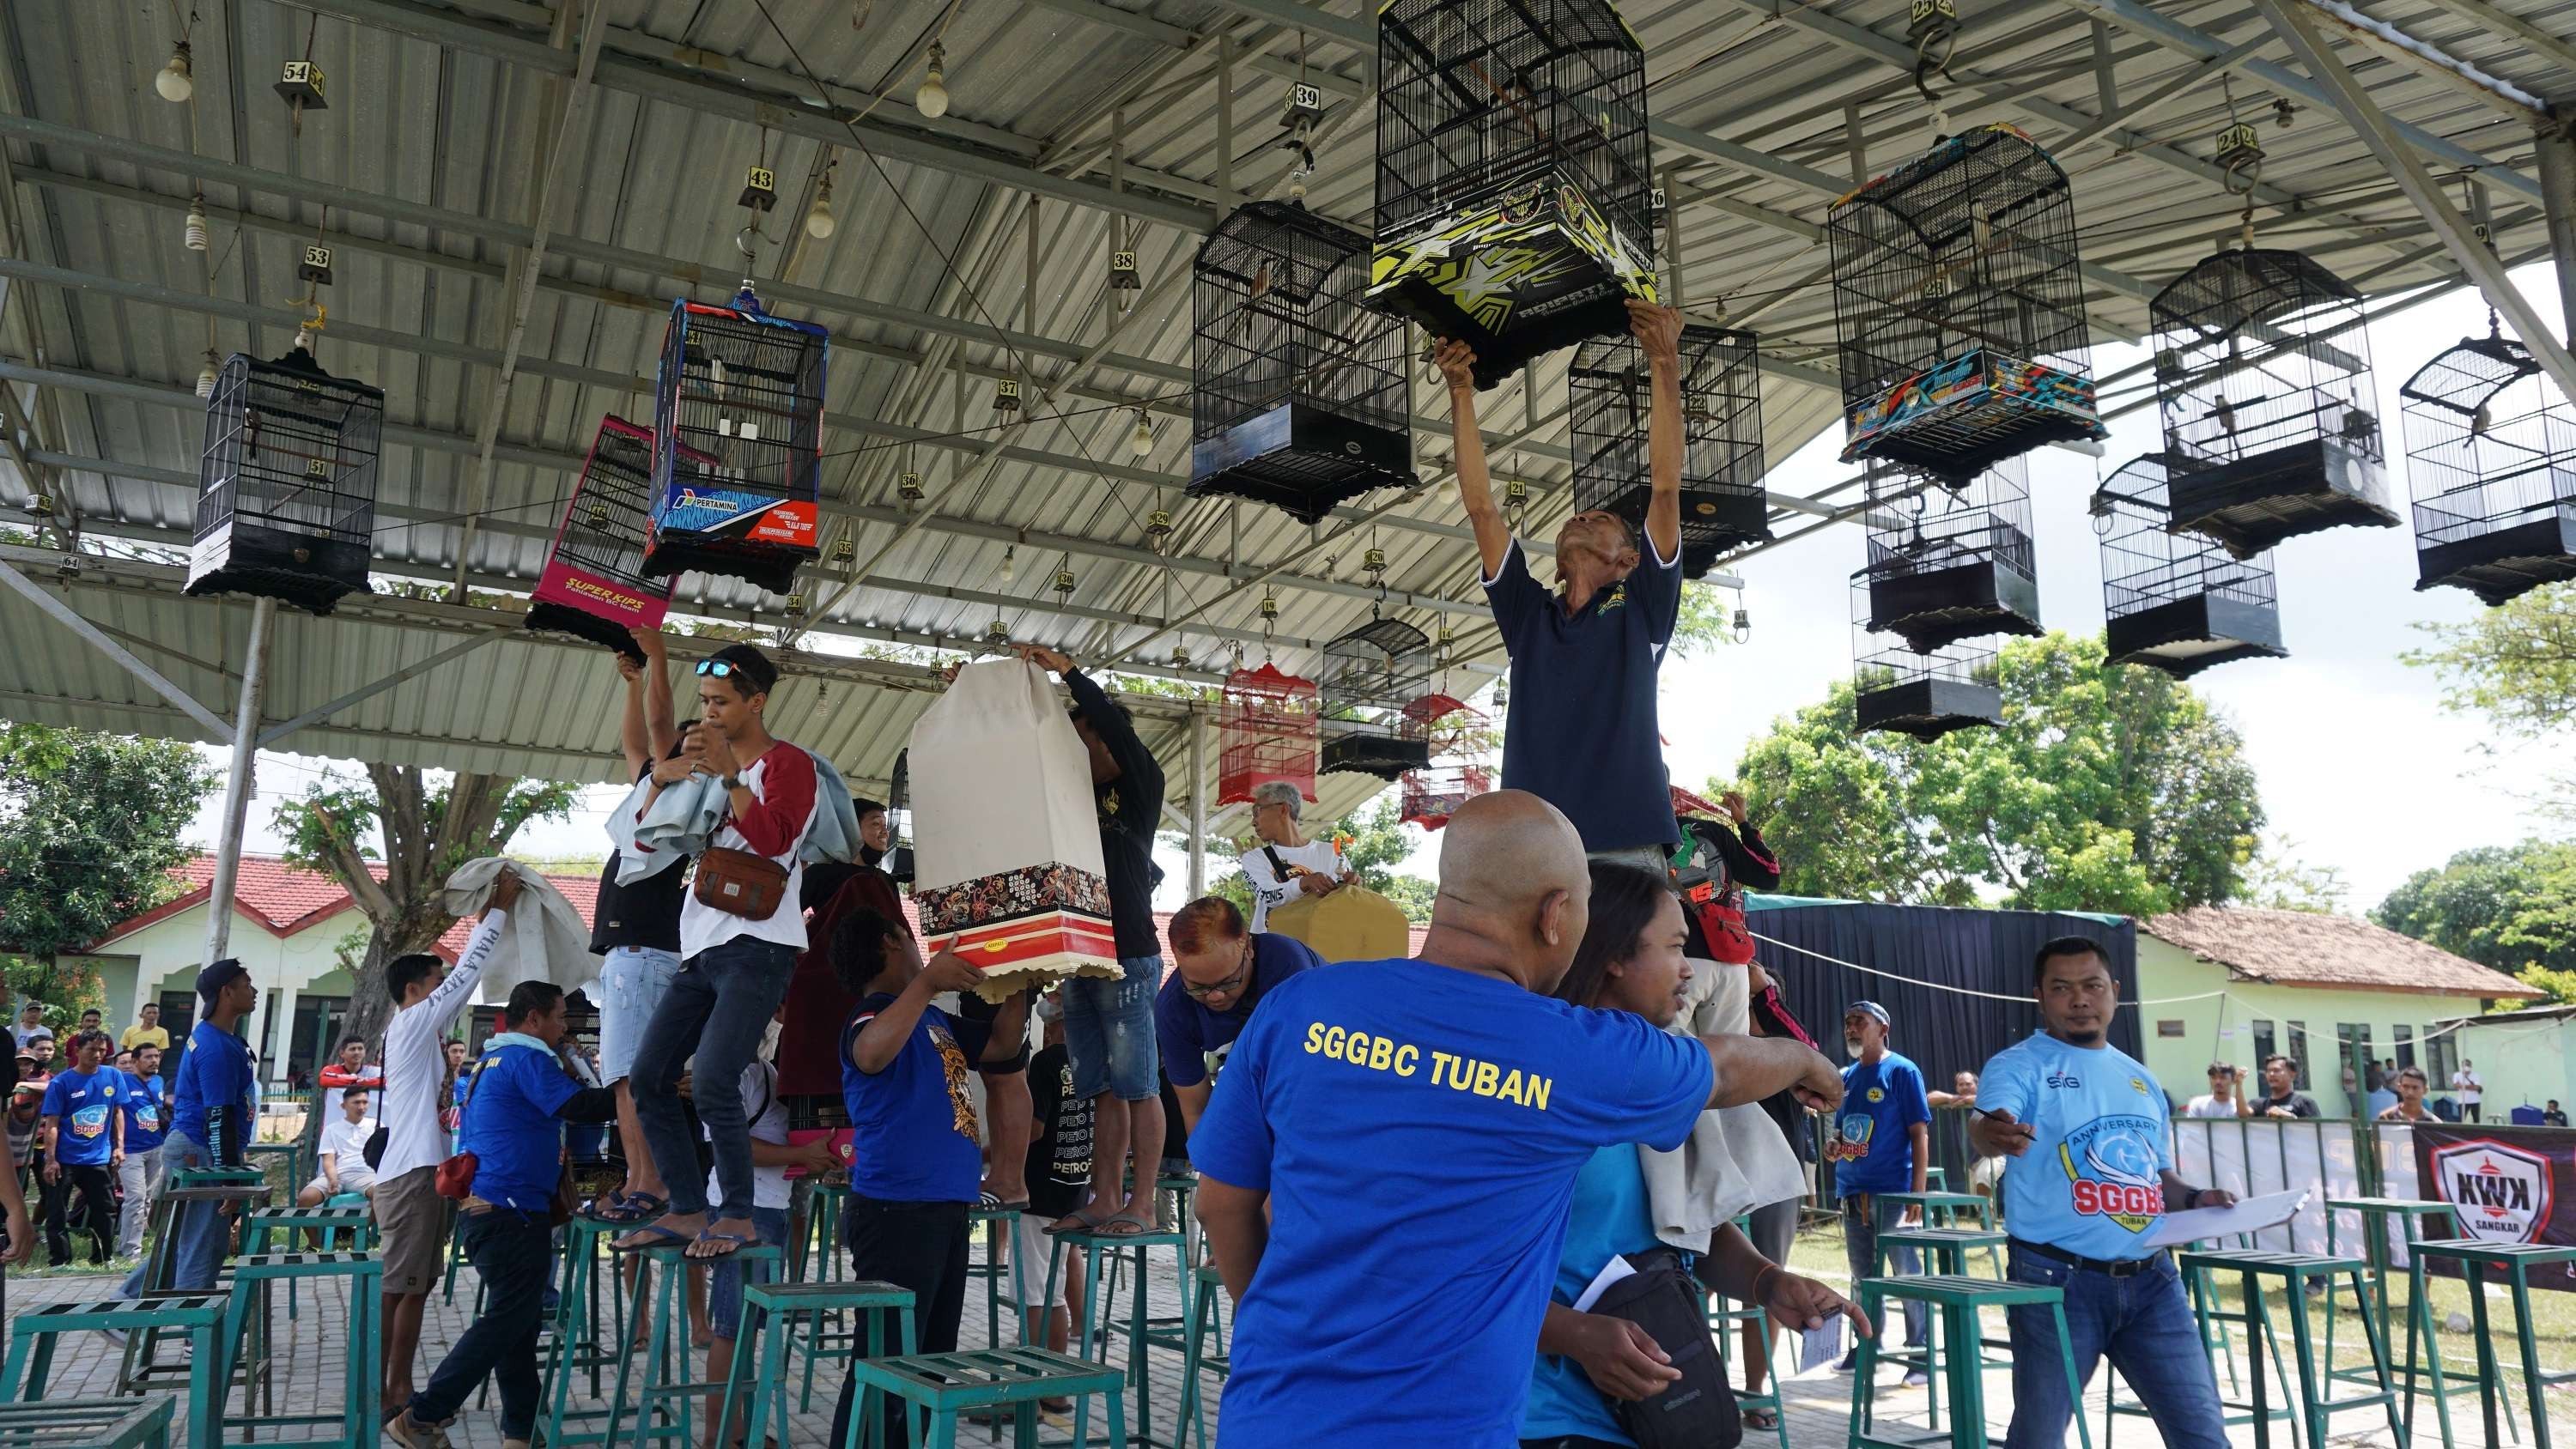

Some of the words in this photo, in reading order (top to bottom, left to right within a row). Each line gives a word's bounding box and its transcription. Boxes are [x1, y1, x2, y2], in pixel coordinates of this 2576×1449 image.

[284, 64, 307, 80] 54
[310, 67, 323, 95] 54
[1297, 87, 1317, 106] 39
[2220, 131, 2238, 152] 24
[2242, 130, 2256, 147] 24
[751, 171, 771, 187] 43
[307, 248, 326, 264] 53
[1115, 254, 1133, 267] 38
[1001, 381, 1016, 394] 37
[311, 461, 325, 473] 51
[902, 475, 916, 486] 36
[1512, 483, 1523, 494] 21
[39, 496, 51, 509] 63
[696, 499, 738, 512] PERTAMINA
[1157, 512, 1169, 524] 29
[840, 543, 851, 554] 35
[64, 557, 78, 567] 64
[1373, 552, 1383, 562] 20
[1062, 574, 1072, 584] 30
[565, 585, 605, 602] Pahlawan
[606, 598, 619, 607] BC
[619, 602, 640, 614] team
[566, 578, 613, 599] SUPER
[612, 593, 646, 610] KIPS
[789, 597, 799, 606] 34
[1265, 602, 1274, 610] 19
[998, 623, 1005, 634] 31
[465, 927, 500, 972] PIALA
[1304, 1022, 1419, 1077] SGGBC
[1430, 1051, 1552, 1111] TUBAN
[2073, 1119, 2159, 1146] ANNIVERSARY
[1839, 1141, 1868, 1157] GGBC
[2121, 1216, 2148, 1227] TUBAN
[2476, 1219, 2520, 1234] SANGKAR
